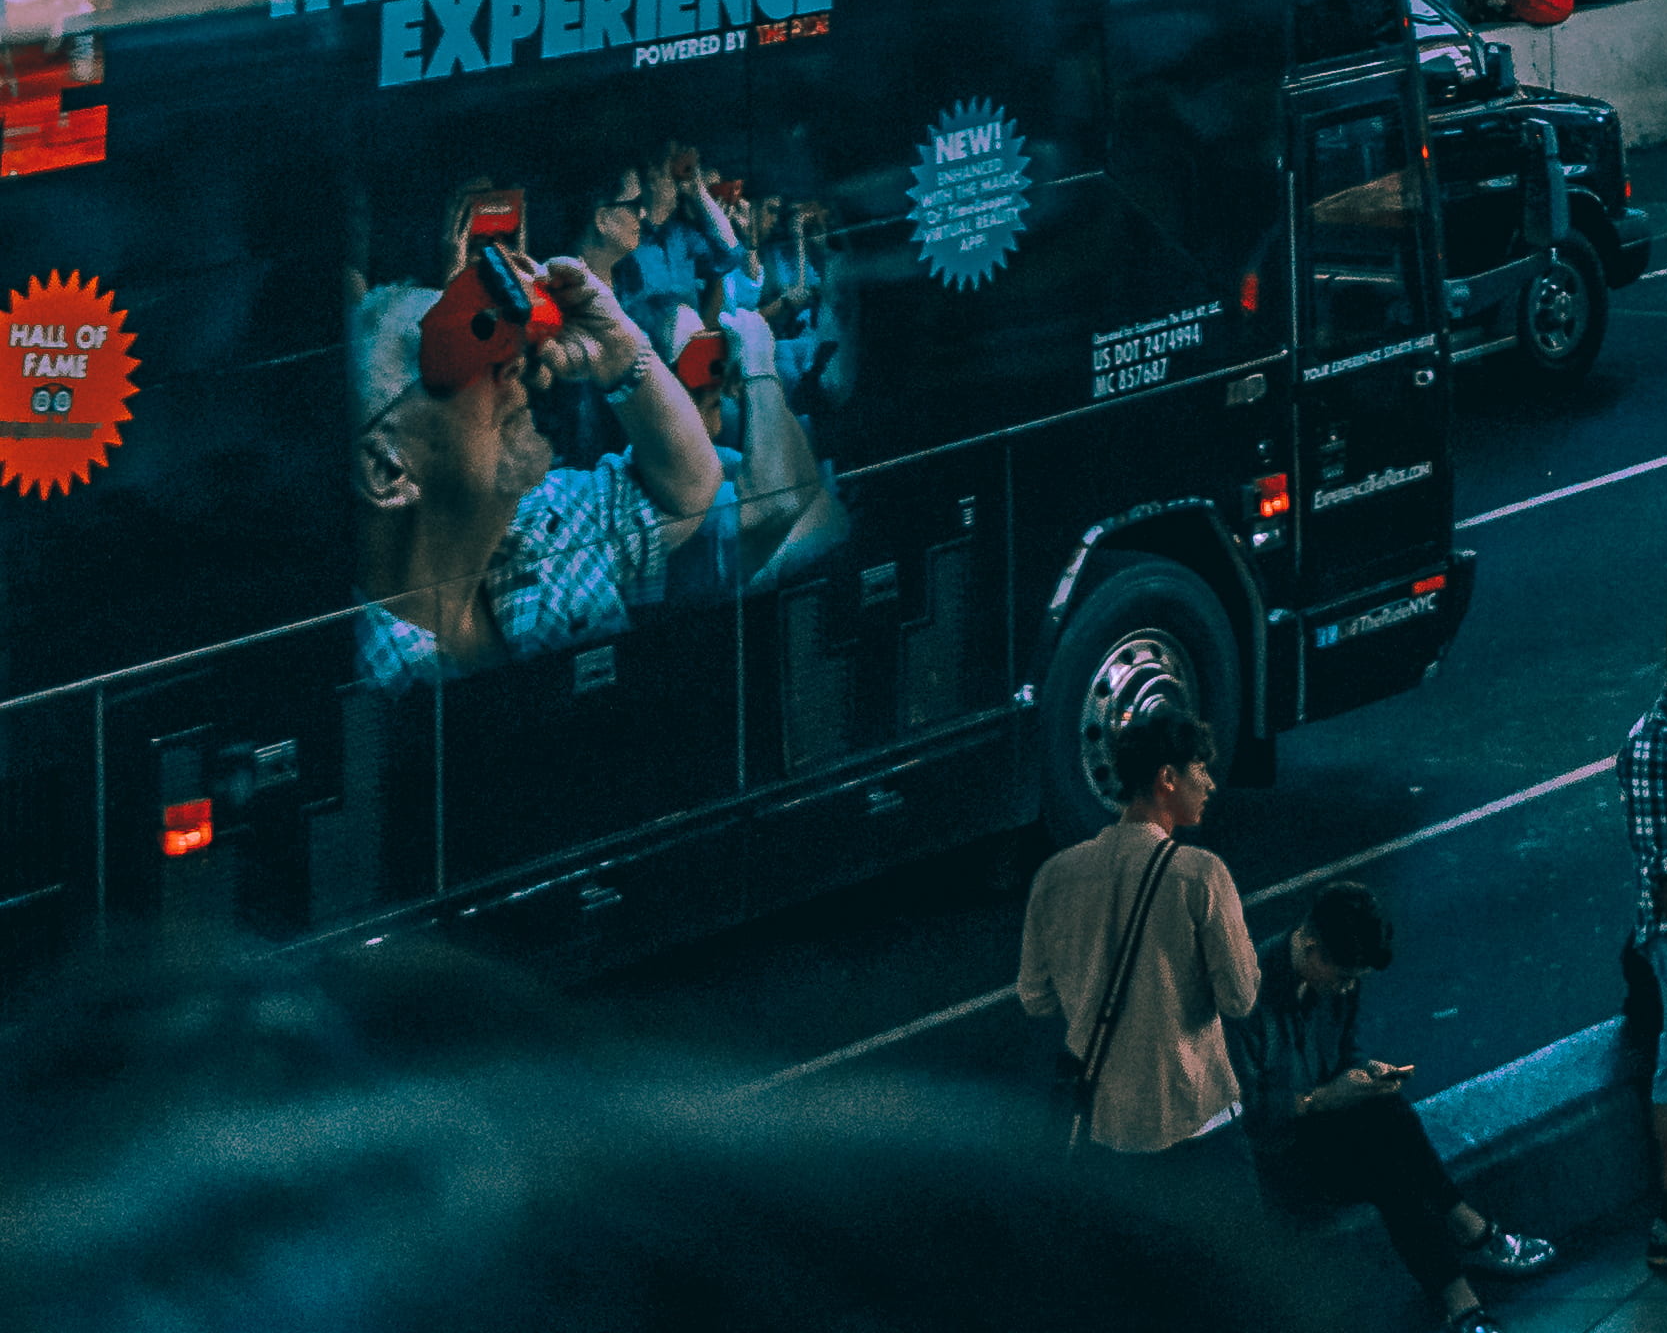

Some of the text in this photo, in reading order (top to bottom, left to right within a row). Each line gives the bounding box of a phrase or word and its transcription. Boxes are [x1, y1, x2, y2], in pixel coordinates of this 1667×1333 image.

[633, 34, 721, 67] POWERED
[724, 29, 749, 52] BY
[935, 121, 1001, 164] NEW!
[9, 323, 109, 349] HALL OF
[22, 353, 88, 379] FAME
[1093, 345, 1111, 371] US
[1115, 339, 1140, 367] DOT
[1093, 375, 1115, 398] MC
